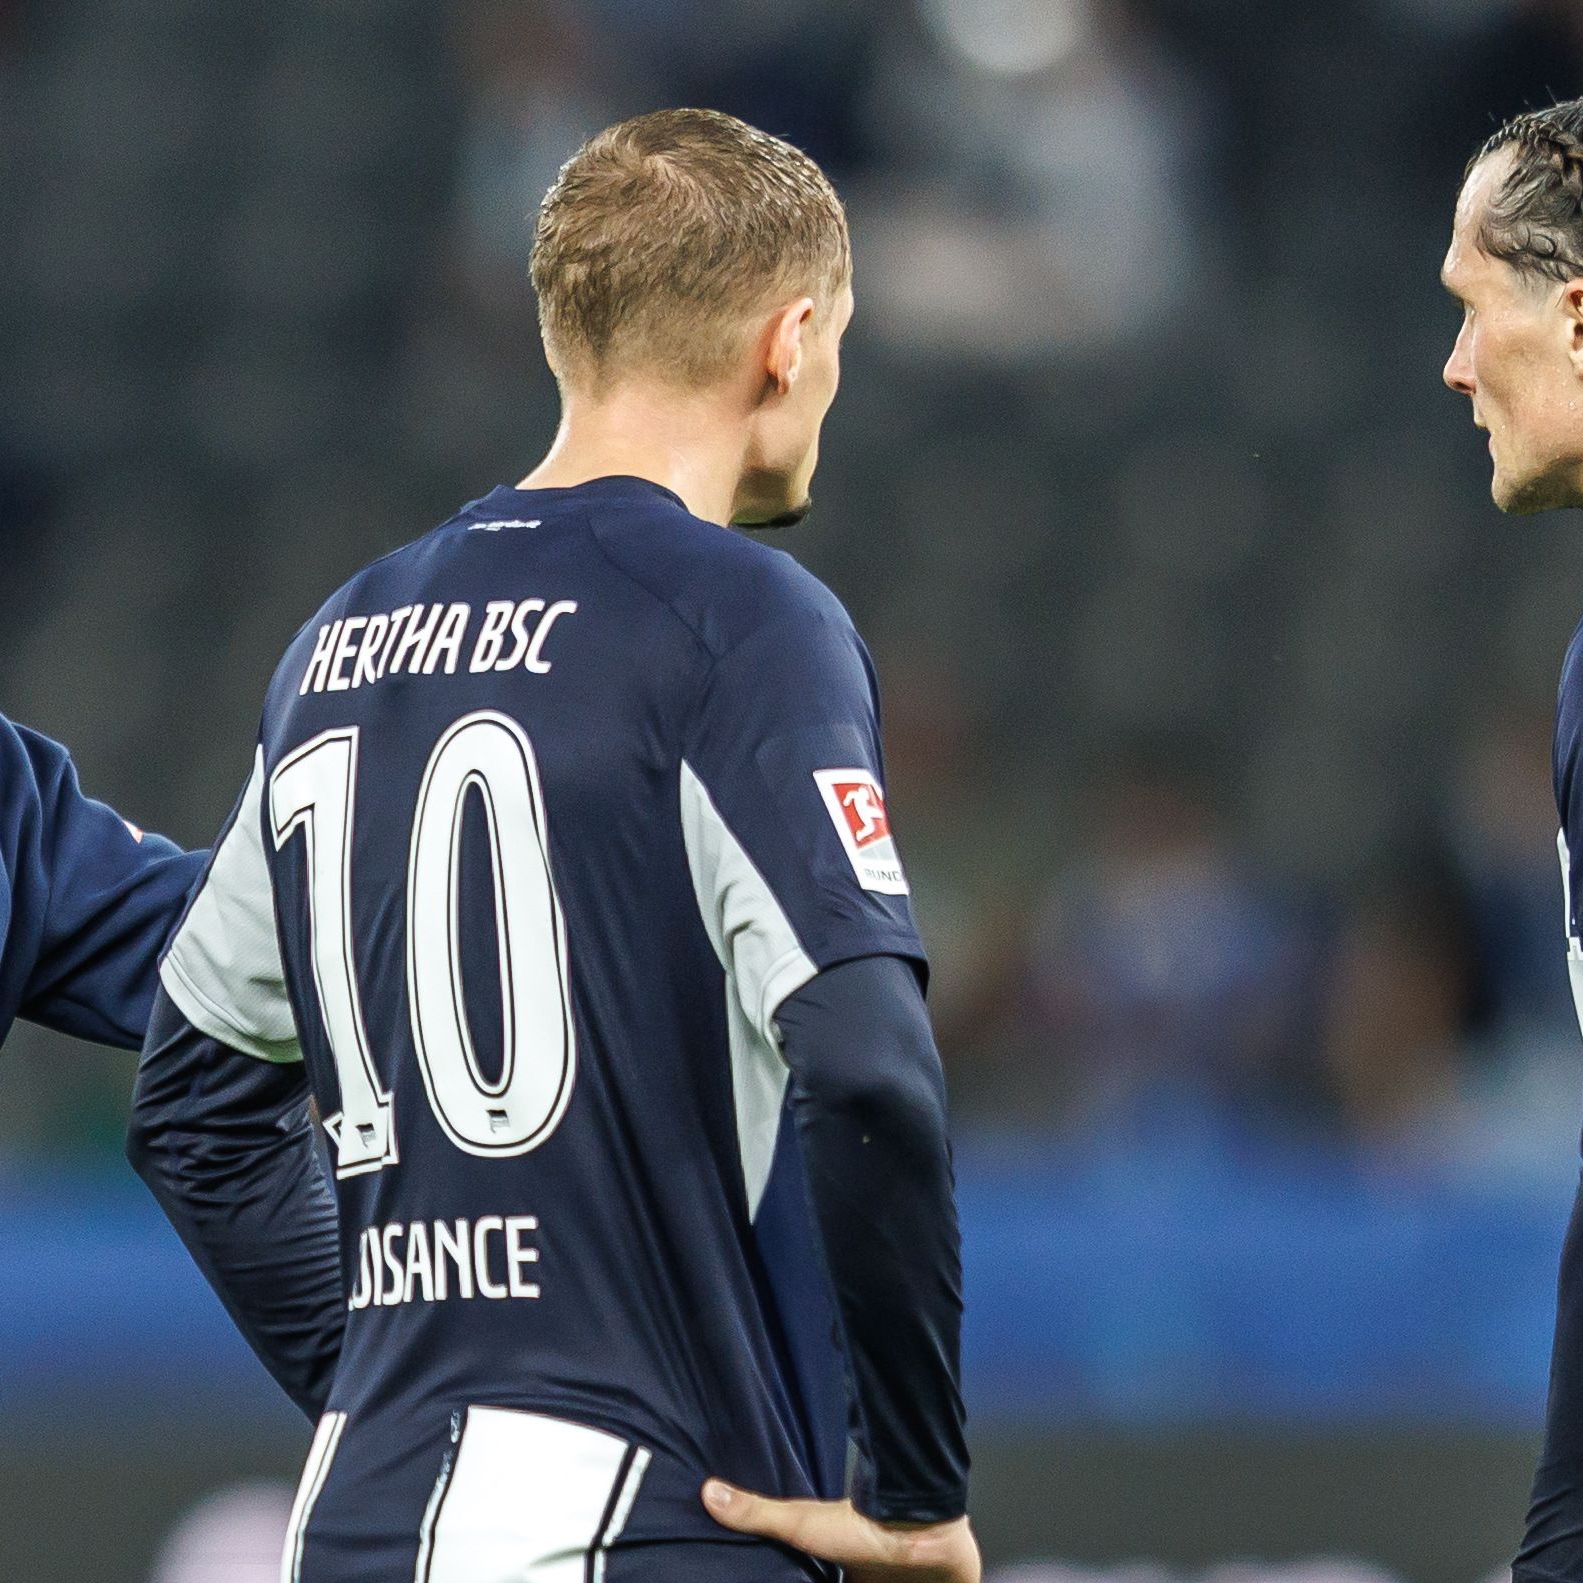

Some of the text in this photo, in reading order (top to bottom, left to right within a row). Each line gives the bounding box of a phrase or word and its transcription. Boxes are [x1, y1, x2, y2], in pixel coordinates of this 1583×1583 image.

[299, 598, 578, 695] HERTHA BSC
[269, 709, 577, 1180] 10
[348, 1214, 542, 1311] UISANCE
